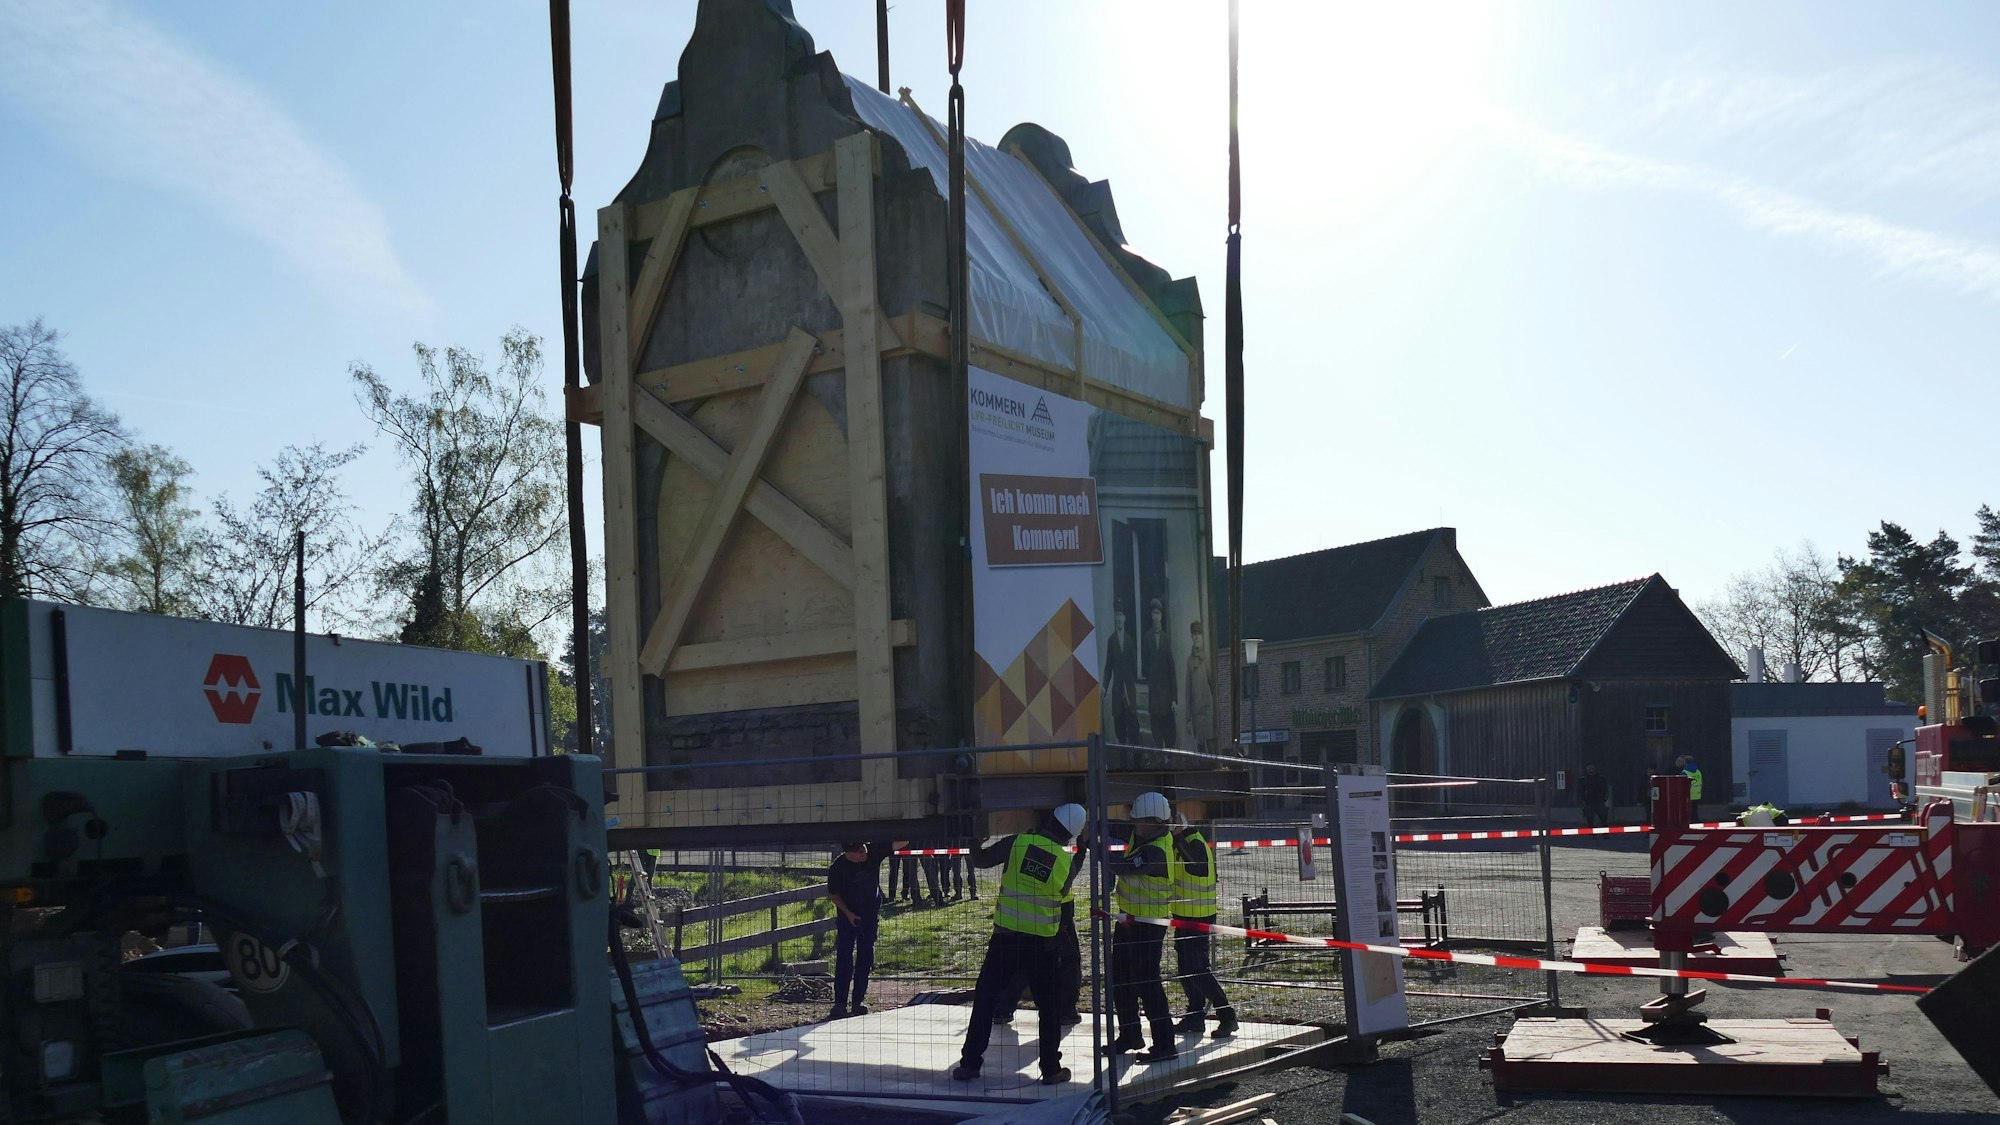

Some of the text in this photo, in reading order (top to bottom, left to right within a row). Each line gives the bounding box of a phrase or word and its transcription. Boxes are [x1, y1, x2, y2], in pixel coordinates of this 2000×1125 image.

[970, 387, 1025, 418] KOMMERN
[971, 408, 1025, 433] LVR-FREILICHT
[1025, 425, 1056, 442] MUSEUM
[990, 487, 1090, 516] Ich komm nach
[1012, 525, 1080, 551] Kommern!
[275, 672, 454, 723] Max Wild
[1023, 860, 1047, 878] JaKo
[238, 938, 280, 980] 80
